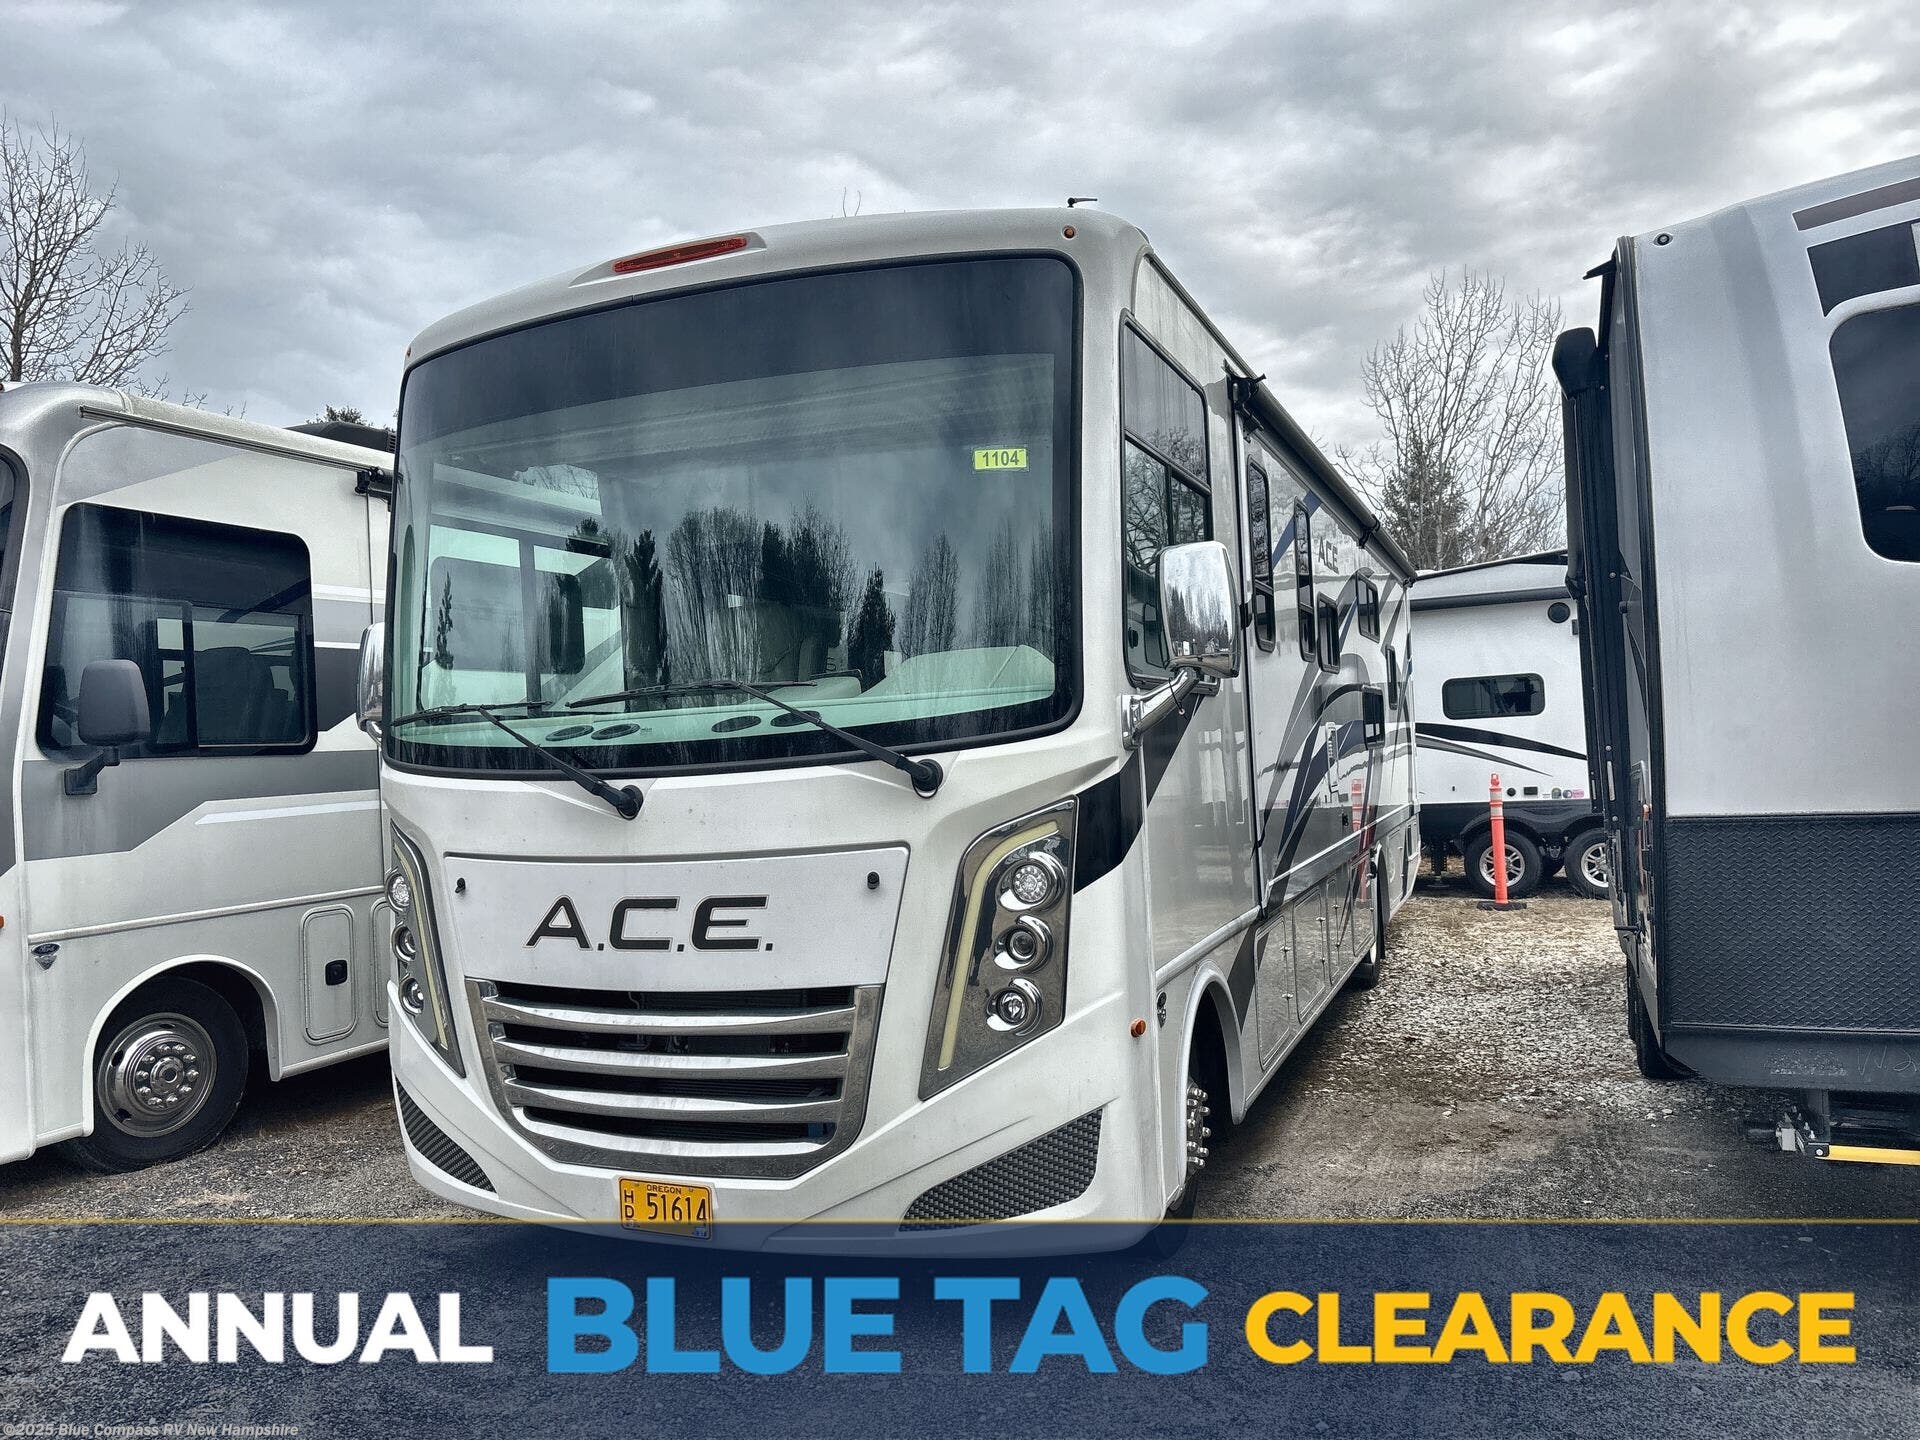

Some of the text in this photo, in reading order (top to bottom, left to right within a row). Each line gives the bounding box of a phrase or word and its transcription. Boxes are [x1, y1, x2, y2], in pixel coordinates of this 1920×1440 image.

[982, 450, 1020, 467] 1104
[1318, 536, 1339, 574] ACE
[522, 894, 774, 952] A.C.E.
[646, 1183, 682, 1195] OREGON
[646, 1192, 707, 1225] 51614
